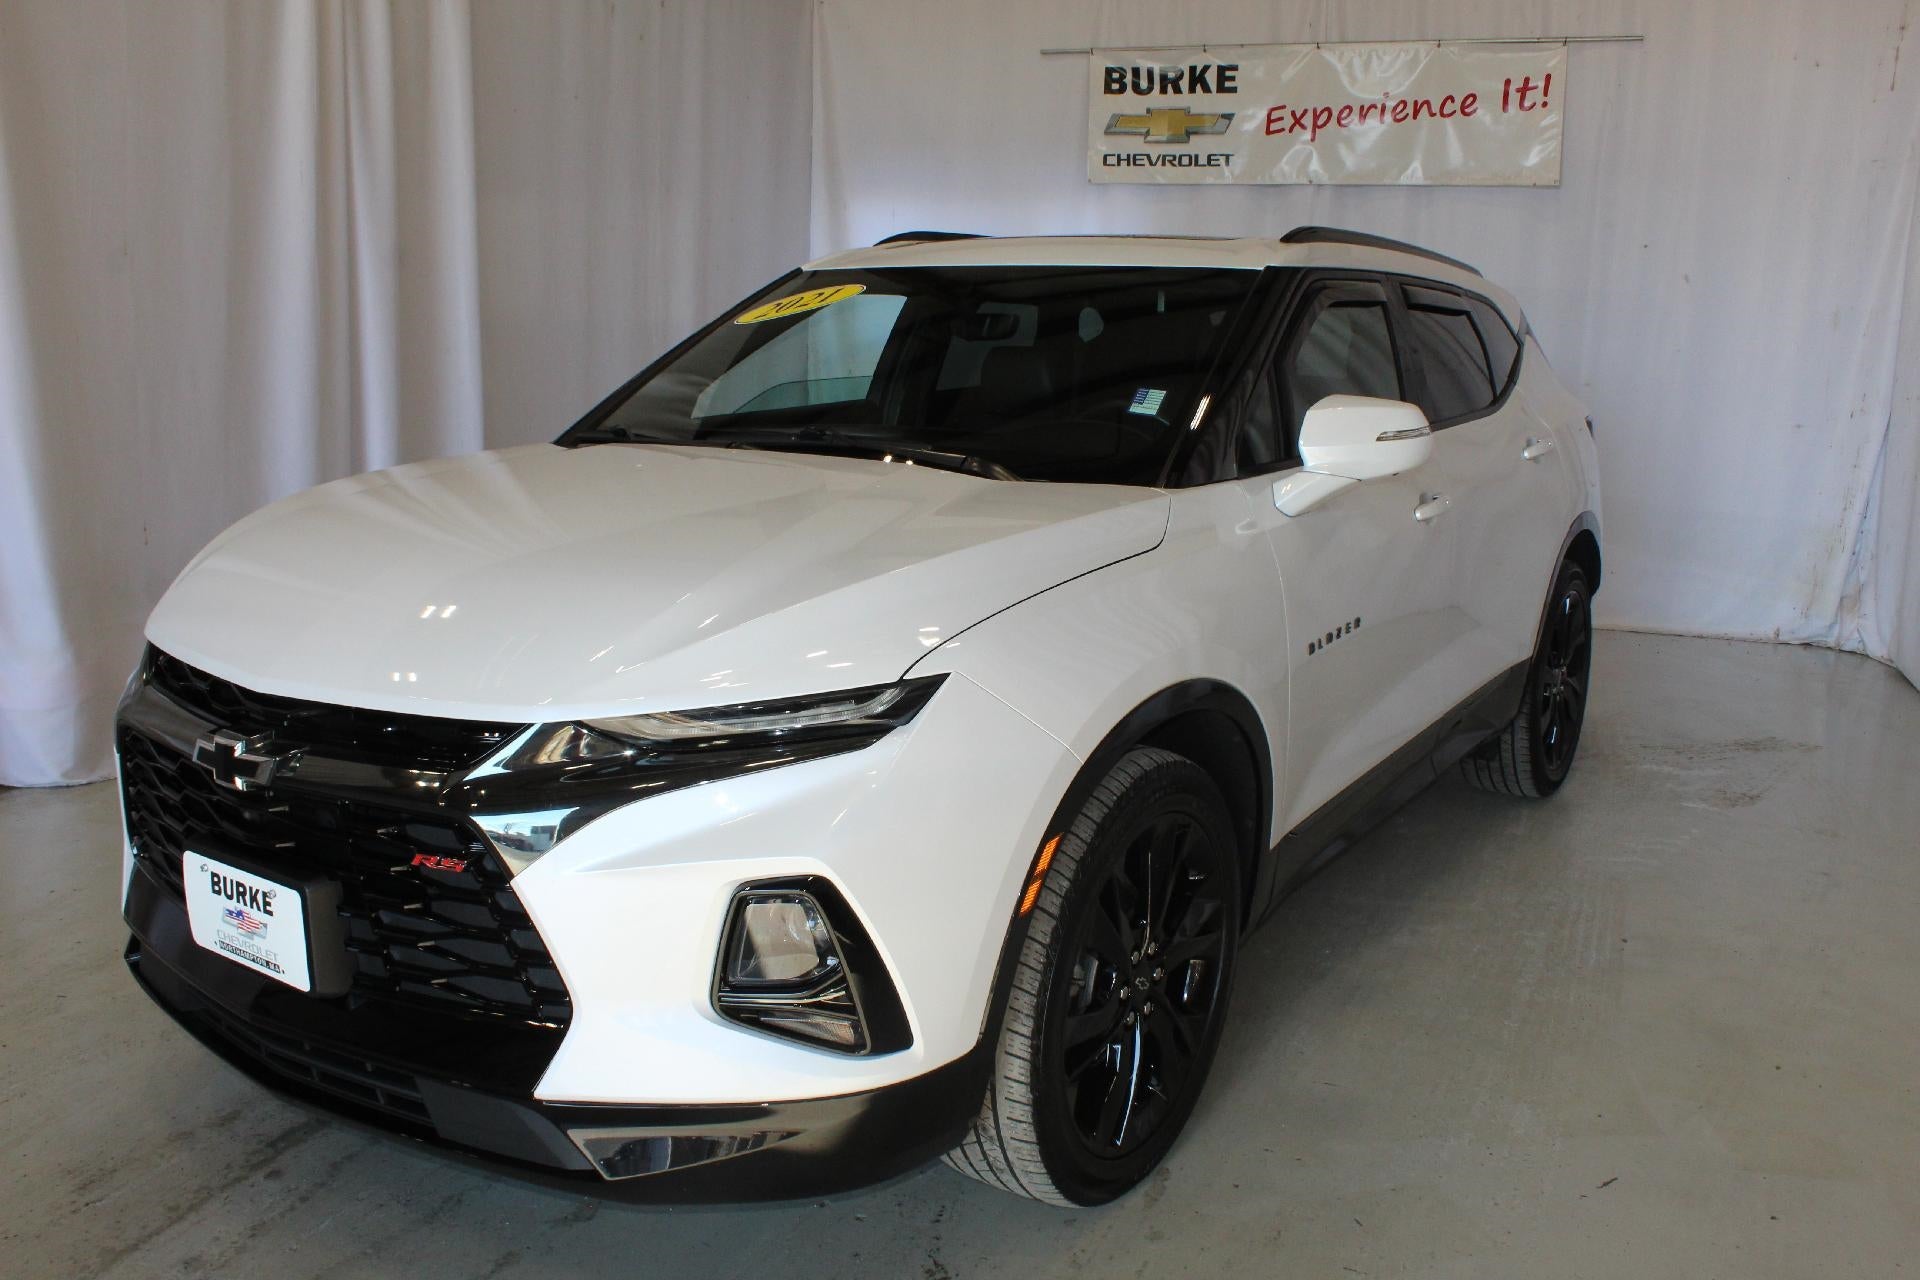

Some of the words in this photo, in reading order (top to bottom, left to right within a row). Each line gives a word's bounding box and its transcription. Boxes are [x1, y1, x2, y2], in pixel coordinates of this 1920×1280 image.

[1104, 64, 1239, 95] BURKE
[1264, 91, 1478, 142] Experience
[1502, 73, 1553, 113] It!
[1102, 153, 1235, 168] CHEVROLET
[753, 287, 845, 320] 2021
[1308, 616, 1361, 656] BLAZER
[410, 853, 467, 873] RS
[210, 870, 274, 917] BURKE
[217, 929, 279, 961] CHEVROLET
